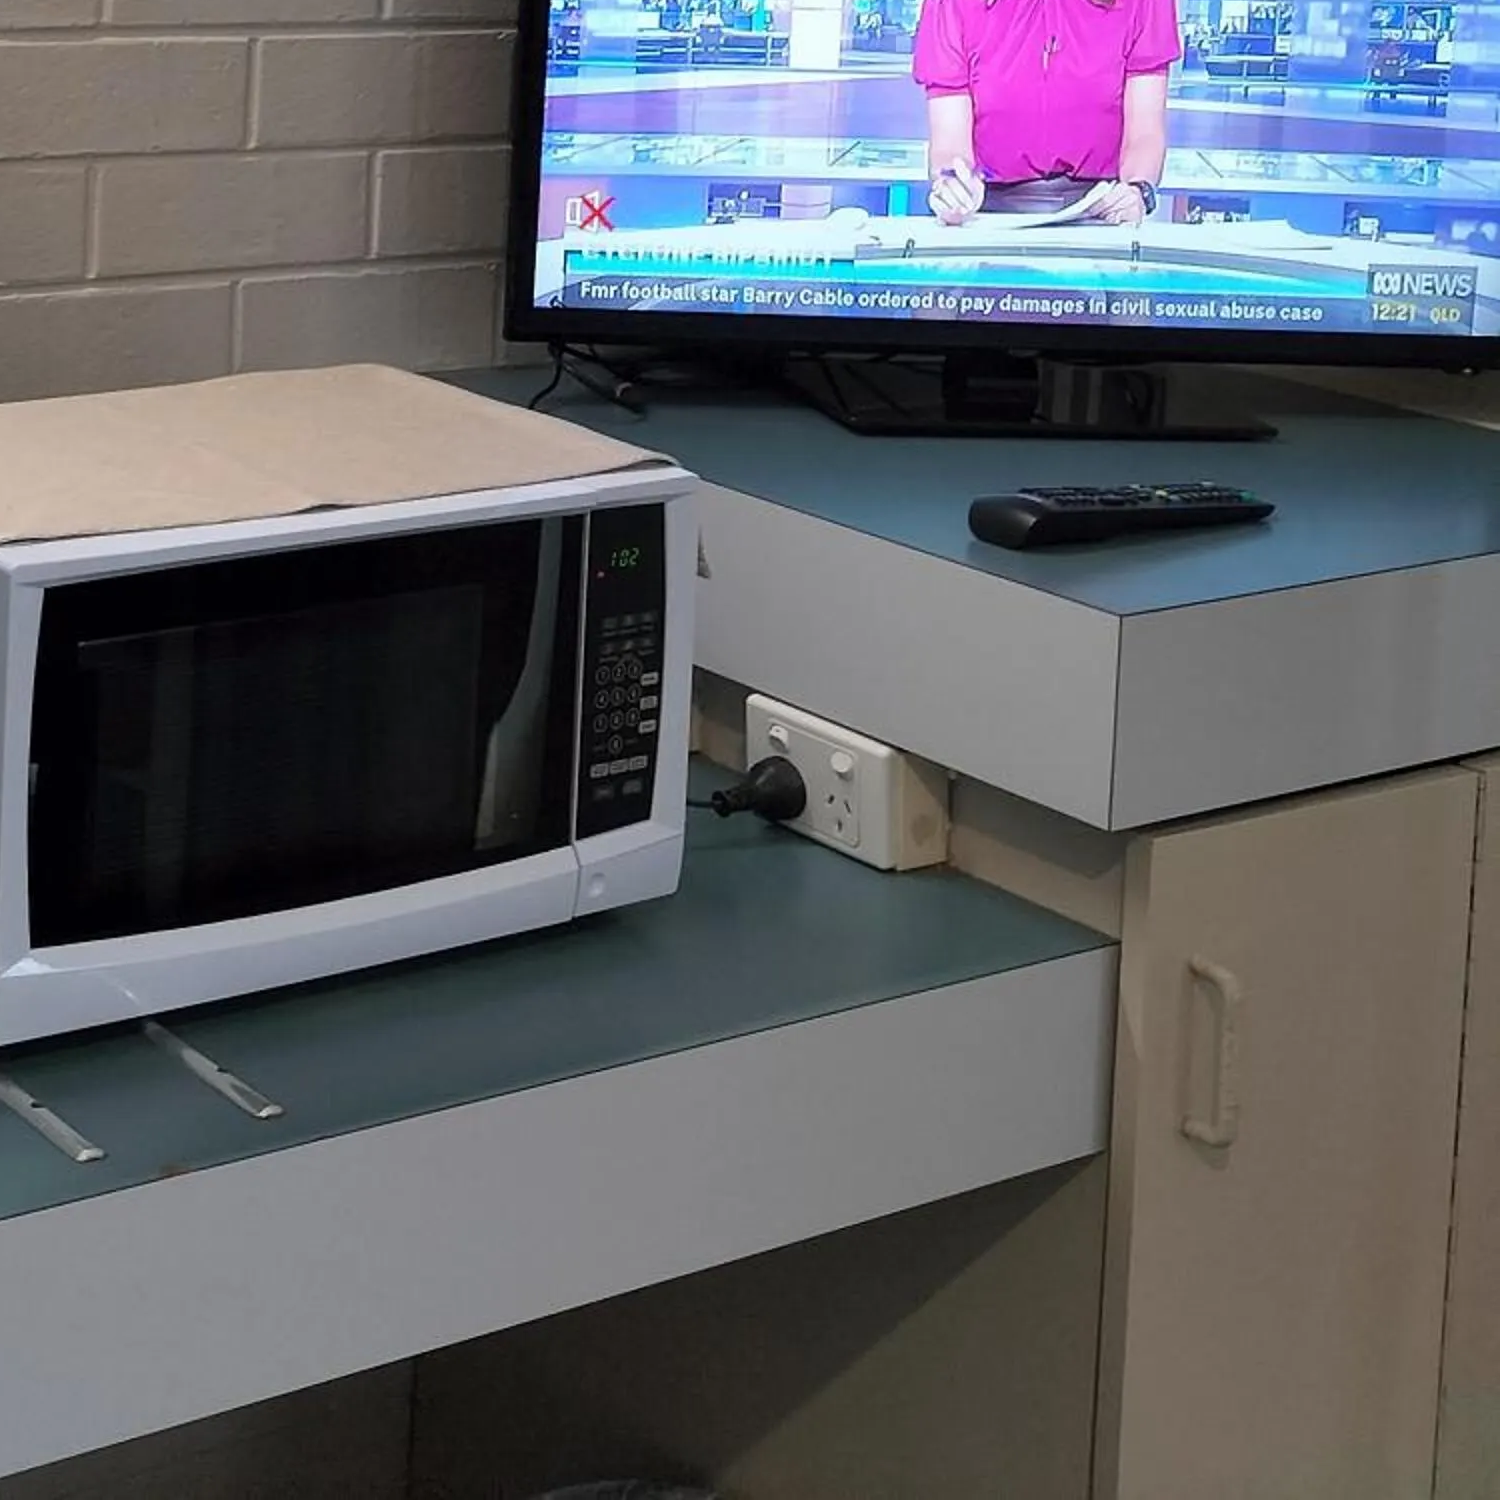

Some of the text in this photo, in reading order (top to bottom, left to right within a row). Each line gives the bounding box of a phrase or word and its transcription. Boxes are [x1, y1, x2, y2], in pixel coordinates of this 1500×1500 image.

[1402, 272, 1473, 297] NEWS
[580, 281, 618, 300] Fmr
[621, 281, 696, 302] football
[699, 286, 738, 303] star
[743, 287, 793, 308] Barry
[858, 290, 933, 309] ordered
[938, 293, 958, 310] to
[960, 297, 995, 315] pay
[999, 293, 1085, 317] damages
[1089, 297, 1107, 315] in
[1110, 297, 1151, 317] civil
[1155, 300, 1217, 318] sexual
[1219, 301, 1277, 320] abuse
[1279, 307, 1324, 321] case
[1429, 306, 1461, 324] QLD
